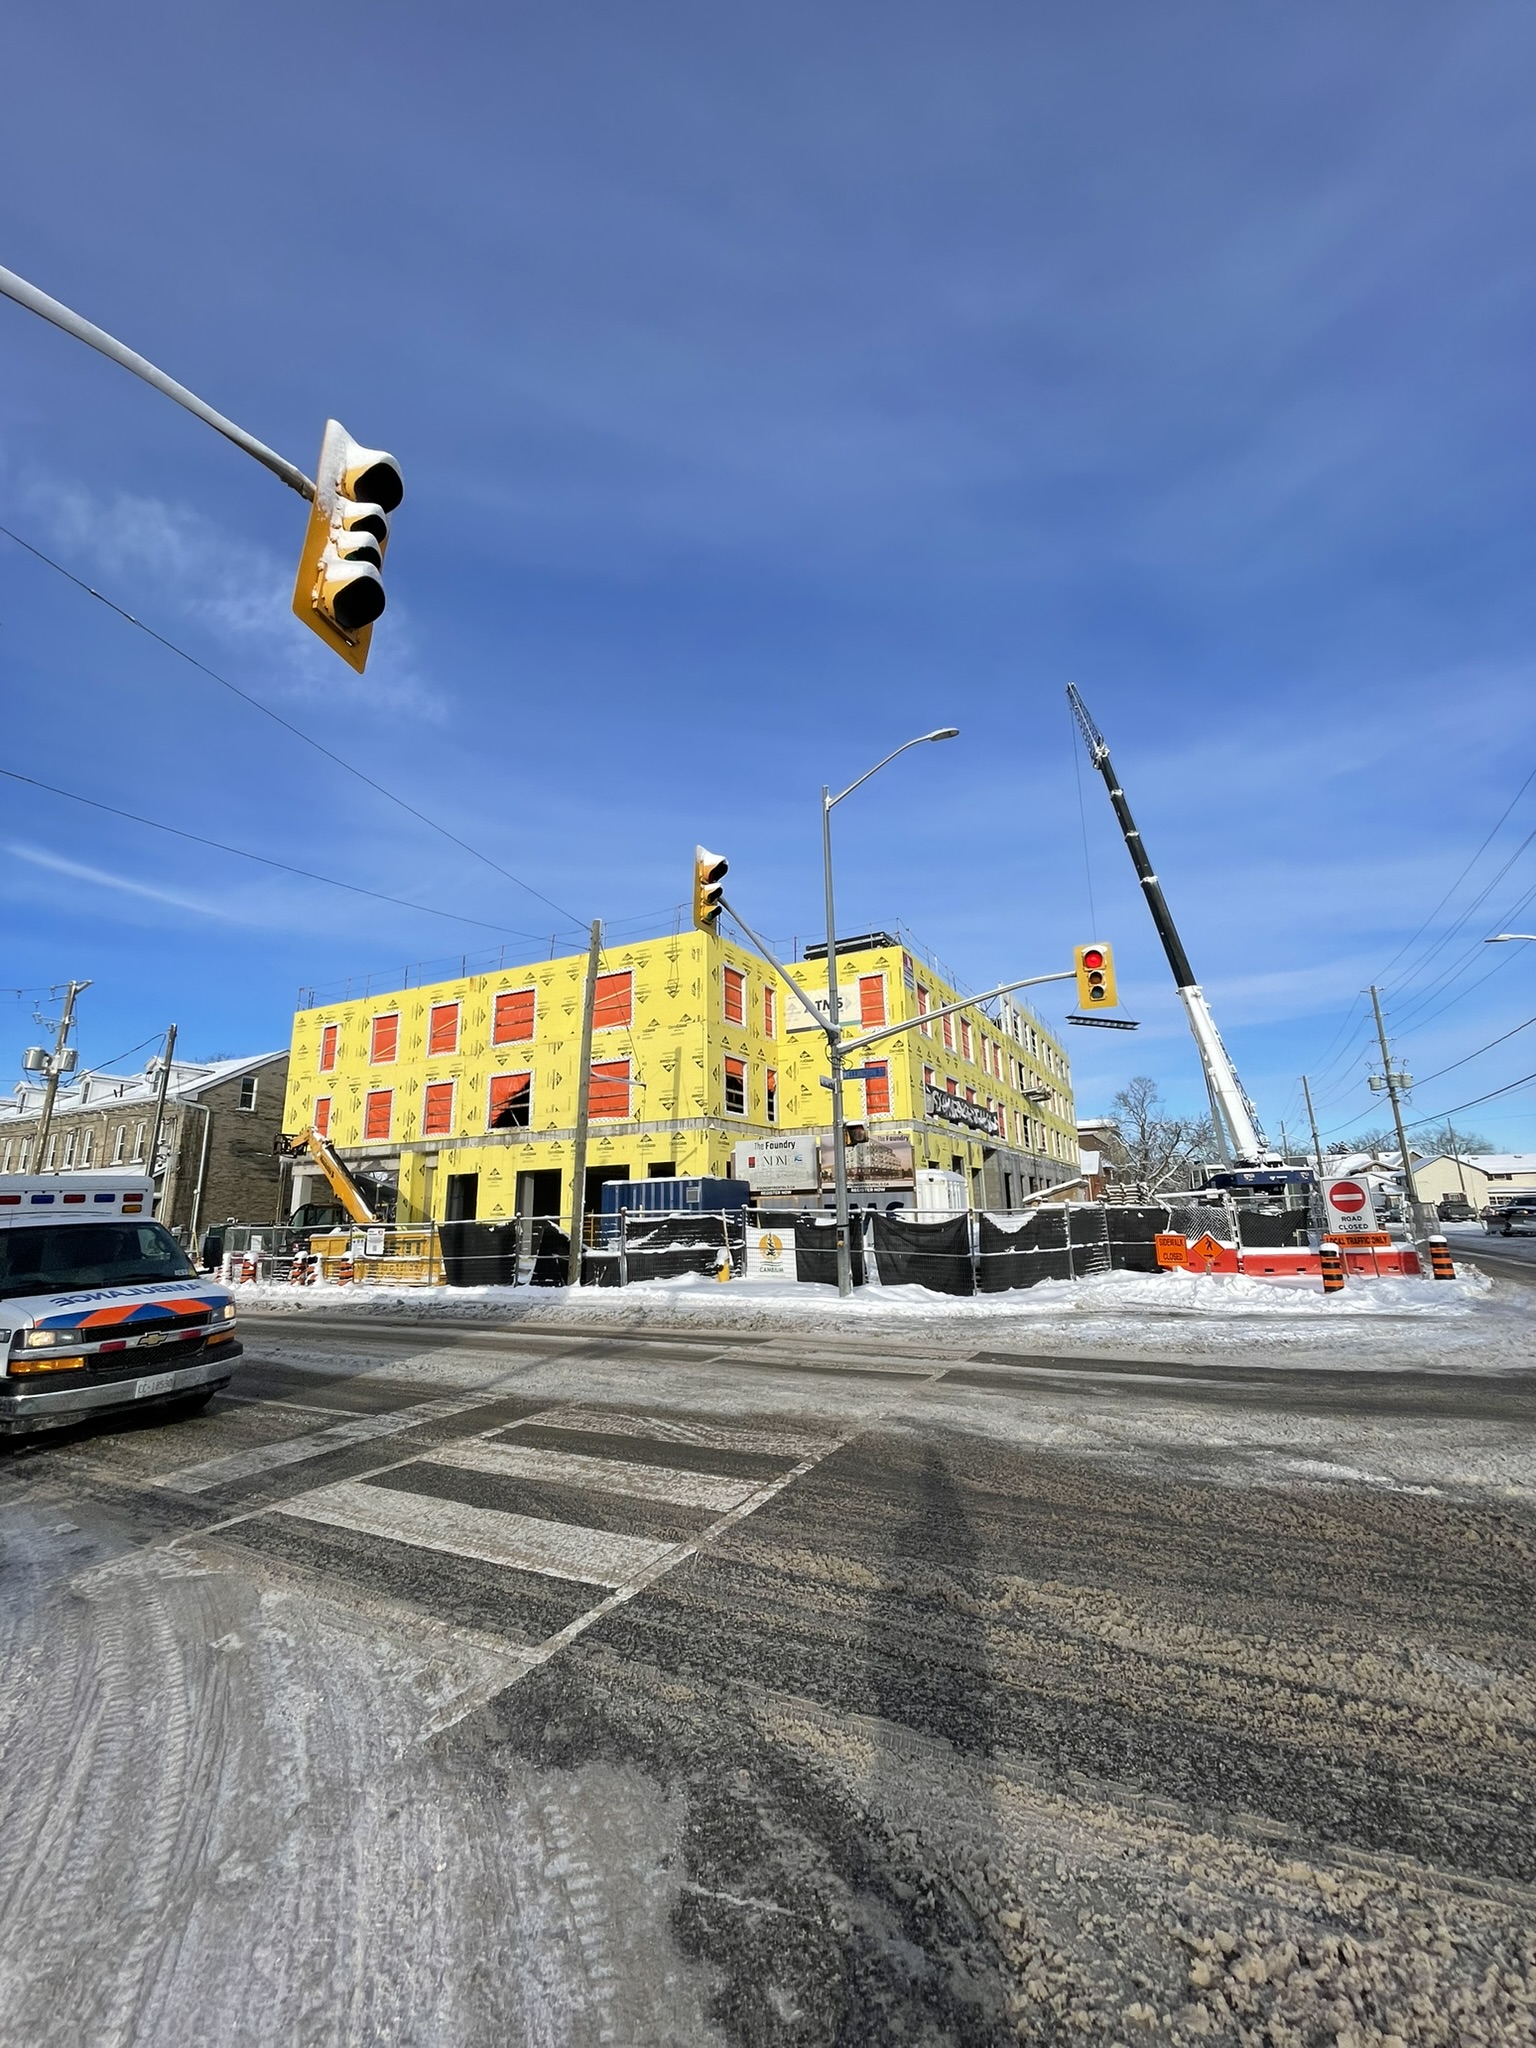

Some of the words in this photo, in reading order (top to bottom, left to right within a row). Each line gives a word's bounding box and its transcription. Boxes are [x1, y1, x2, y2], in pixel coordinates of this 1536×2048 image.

[754, 1142, 764, 1150] The
[765, 1140, 796, 1150] Foundry
[1159, 1238, 1184, 1247] SIDEWALK
[1326, 1237, 1346, 1245] LOCAL
[1345, 1236, 1371, 1245] TRAFFIC
[1371, 1235, 1388, 1244] ONLY
[1163, 1252, 1183, 1261] CLOSED
